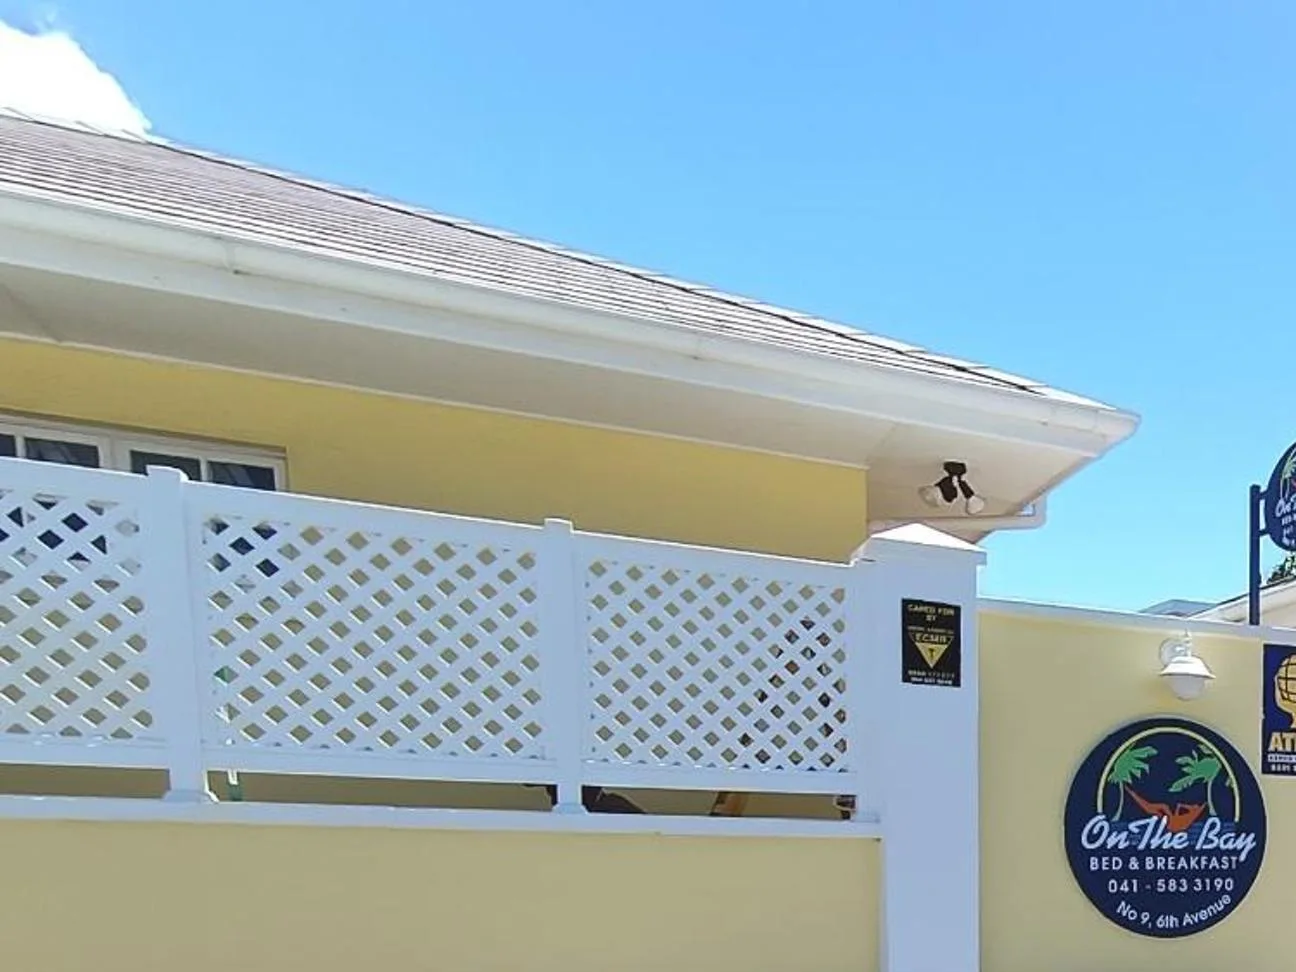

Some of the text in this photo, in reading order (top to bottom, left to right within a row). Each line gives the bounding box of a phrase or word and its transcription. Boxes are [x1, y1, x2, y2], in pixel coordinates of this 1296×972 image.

[1081, 814, 1257, 862] On The Bay
[1089, 856, 1239, 871] BED & BREAKFAST
[1108, 879, 1139, 893] 041
[1156, 878, 1188, 893] 583
[1193, 877, 1235, 892] 3190
[1116, 901, 1138, 921] No
[1156, 914, 1180, 929] 6th
[1182, 894, 1232, 927] Avenue
